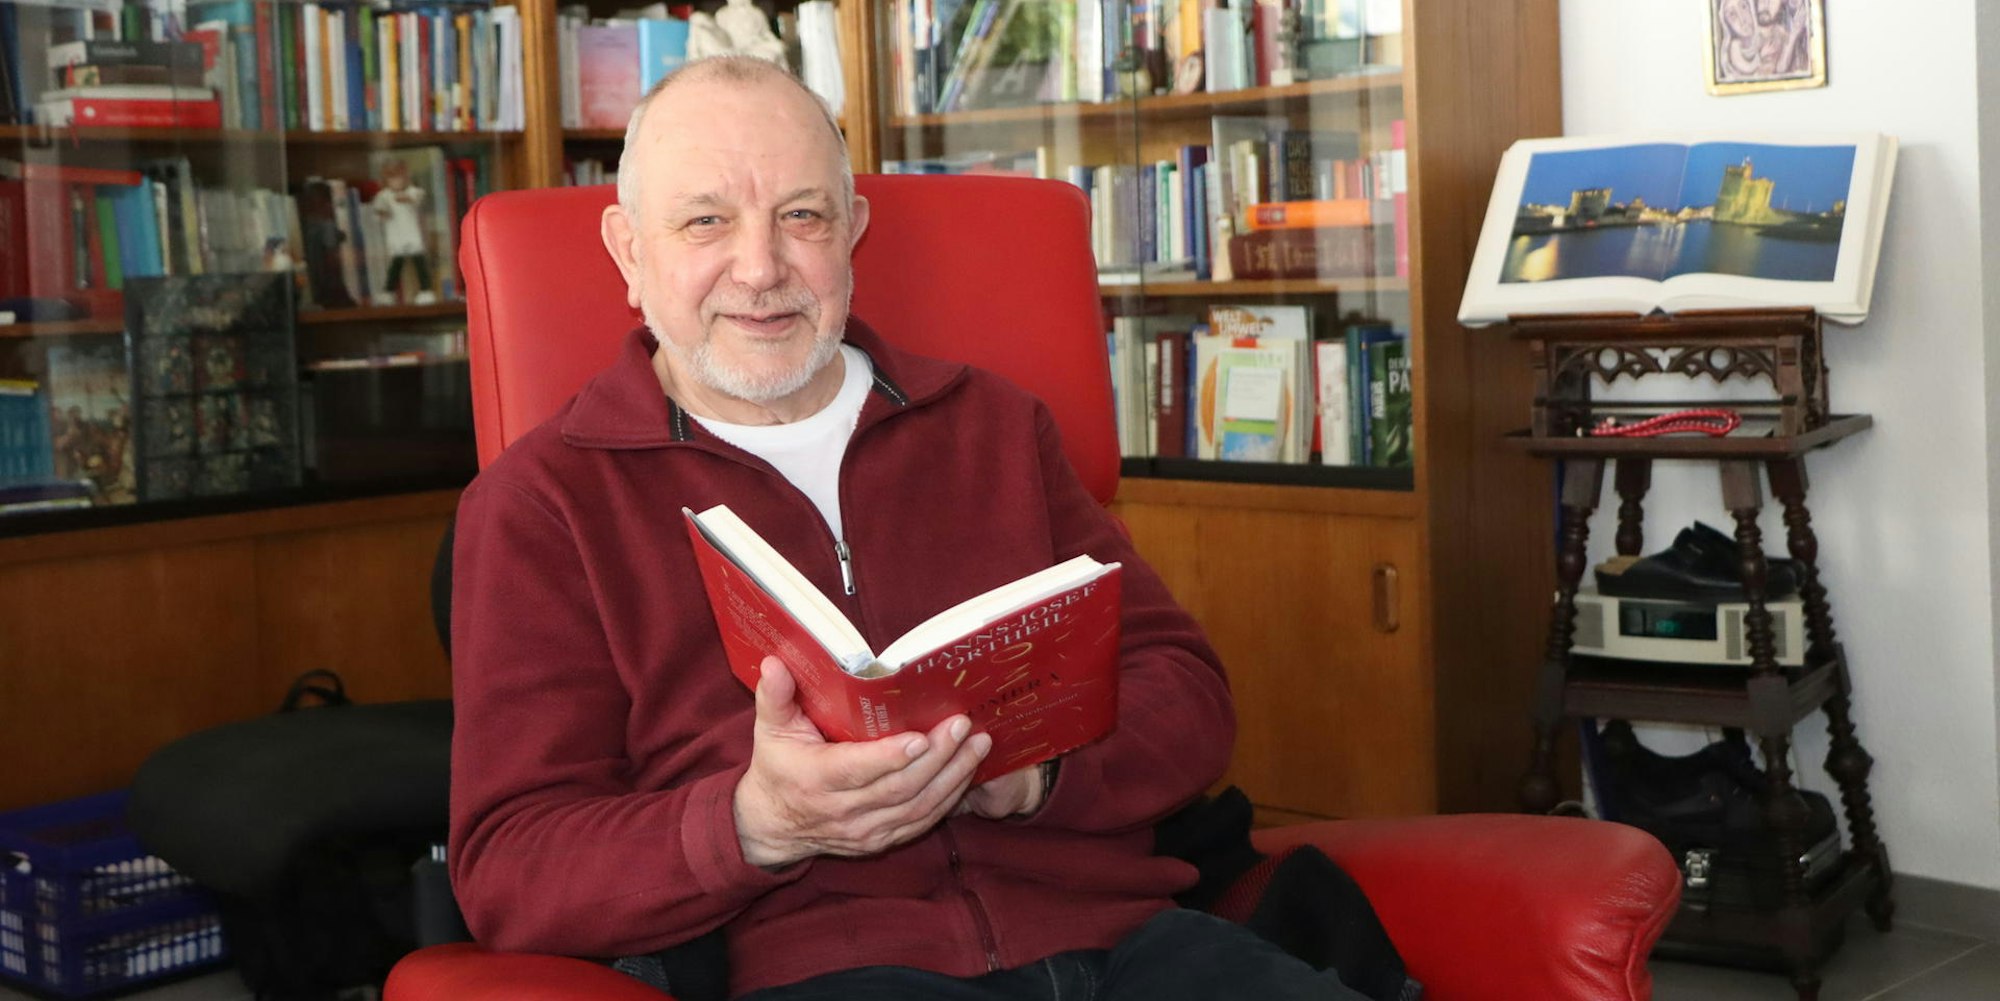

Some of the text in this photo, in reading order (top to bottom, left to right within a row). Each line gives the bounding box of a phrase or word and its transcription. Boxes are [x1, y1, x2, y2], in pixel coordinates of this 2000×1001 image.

[1211, 309, 1242, 323] WELT
[1219, 321, 1264, 336] UMWELT
[916, 582, 1098, 674] HANNS-JOSEF
[945, 613, 1068, 671] ORTHEIL
